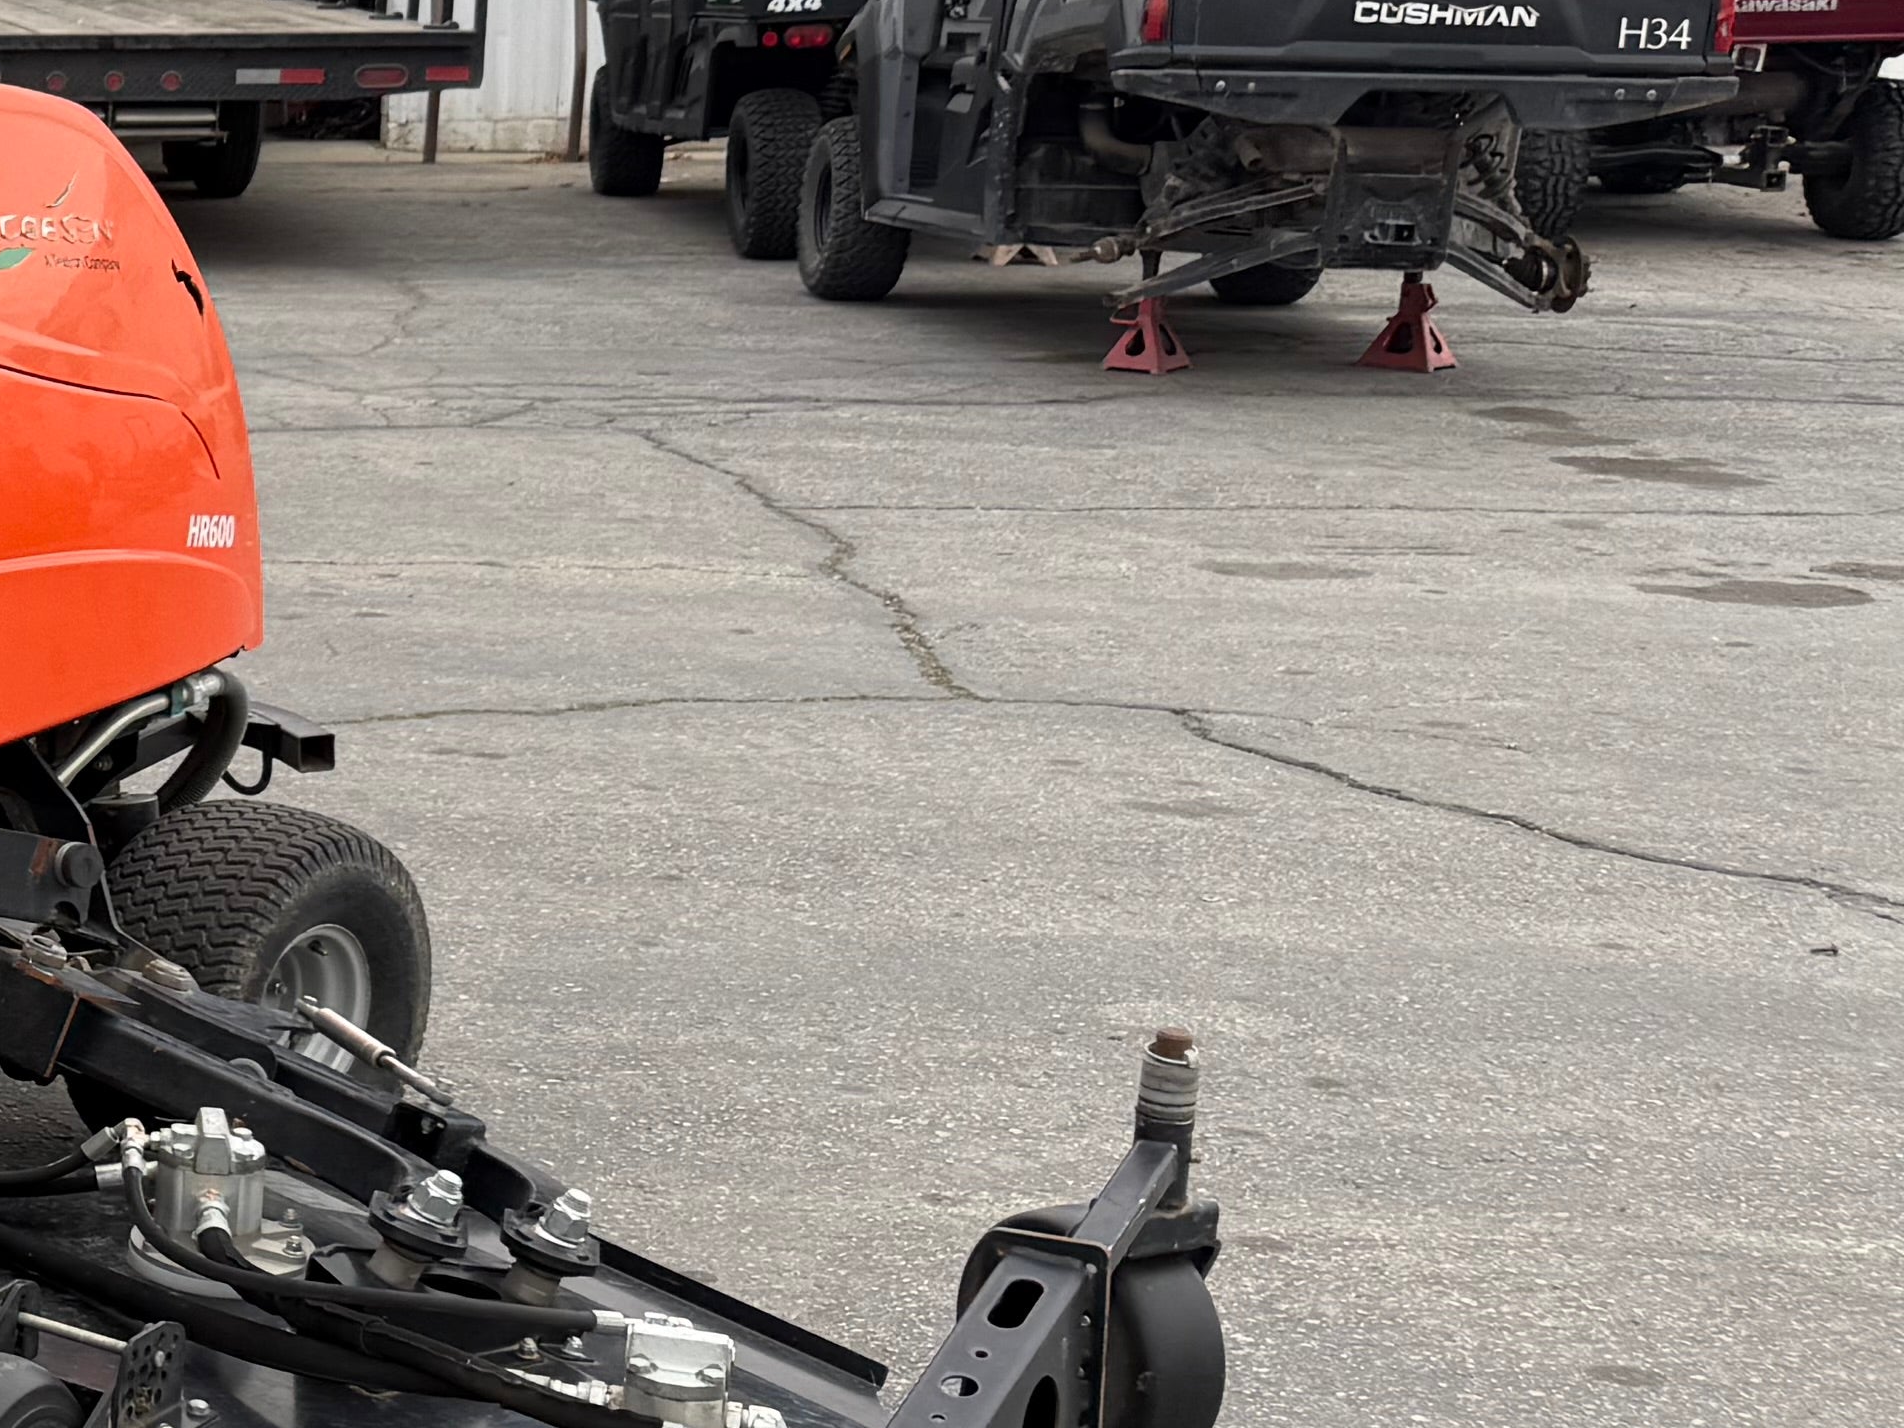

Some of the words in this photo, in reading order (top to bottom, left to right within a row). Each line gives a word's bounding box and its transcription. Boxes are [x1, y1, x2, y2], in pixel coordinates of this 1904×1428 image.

[1353, 0, 1540, 27] CUSHMAN
[1617, 16, 1692, 50] H34
[186, 514, 235, 548] HR600
